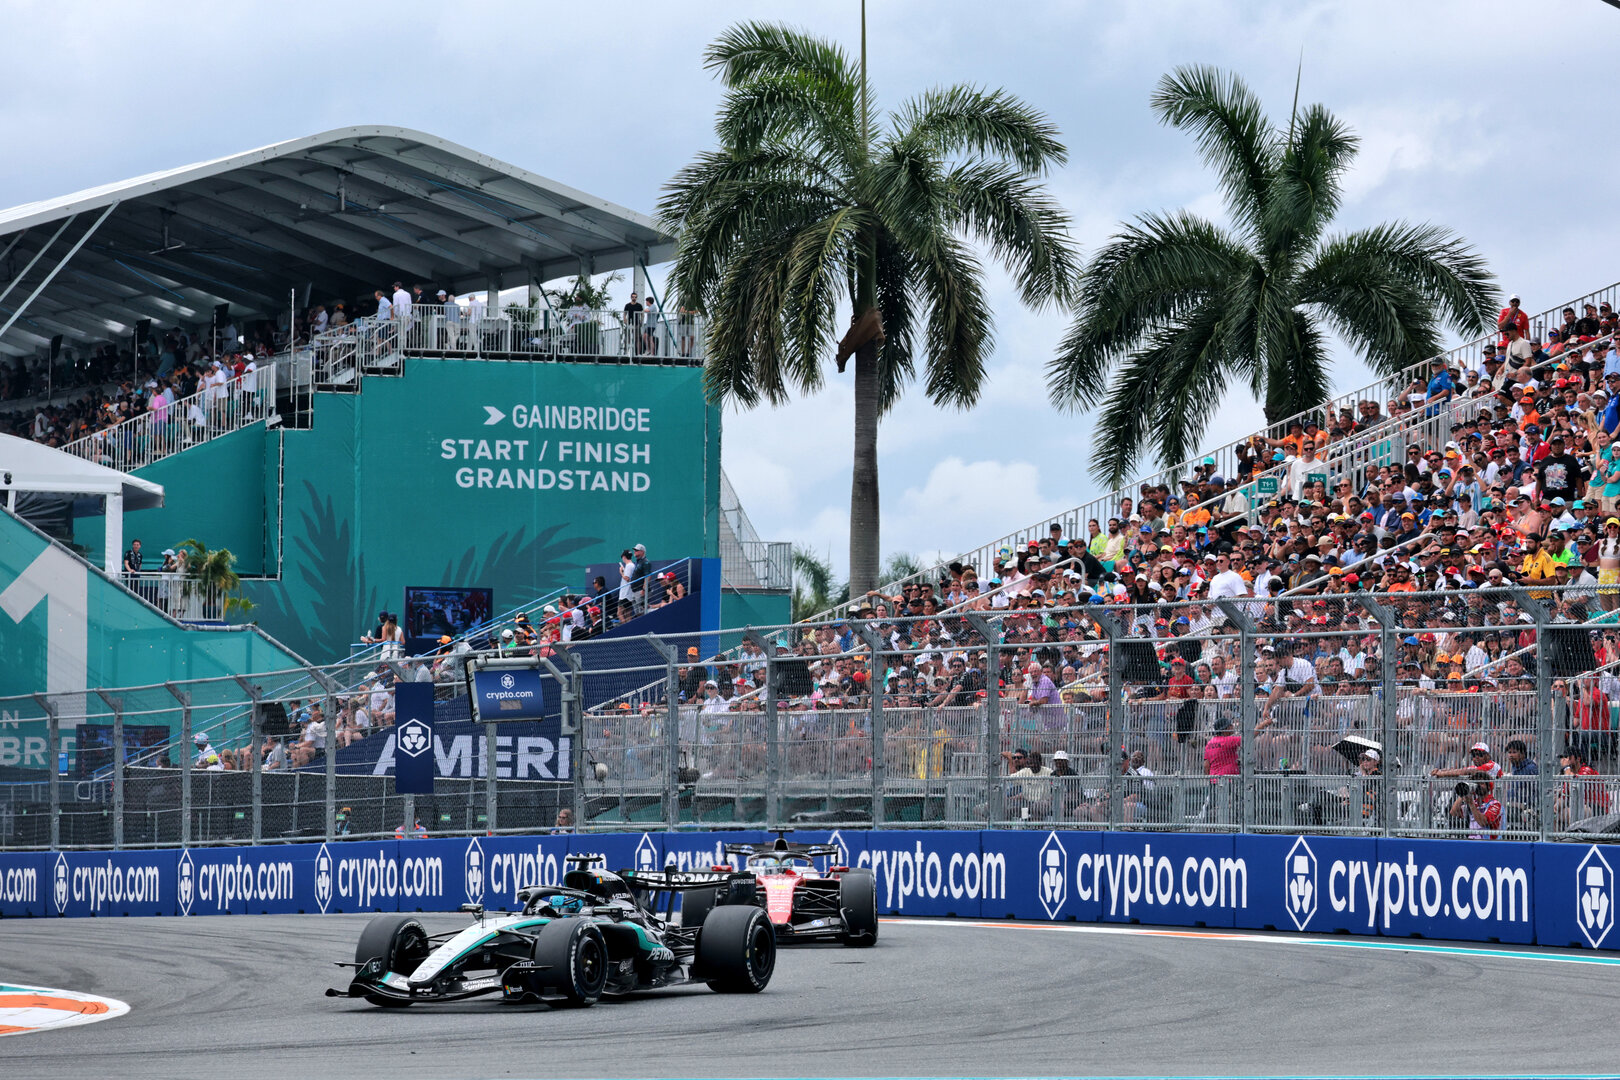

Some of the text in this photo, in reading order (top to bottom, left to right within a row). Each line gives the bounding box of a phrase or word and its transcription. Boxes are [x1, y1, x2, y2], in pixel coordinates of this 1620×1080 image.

[512, 404, 650, 431] GAINBRIDGE
[440, 438, 650, 464] START / FINISH
[455, 467, 650, 492] GRANDSTAND
[486, 691, 533, 699] crypto.com
[0, 868, 37, 902] .com
[73, 858, 160, 911] crypto.com
[199, 855, 293, 910] crypto.com
[338, 850, 443, 907] crypto.com
[1076, 844, 1247, 917] crypto.com
[1329, 851, 1529, 928] crypto.com
